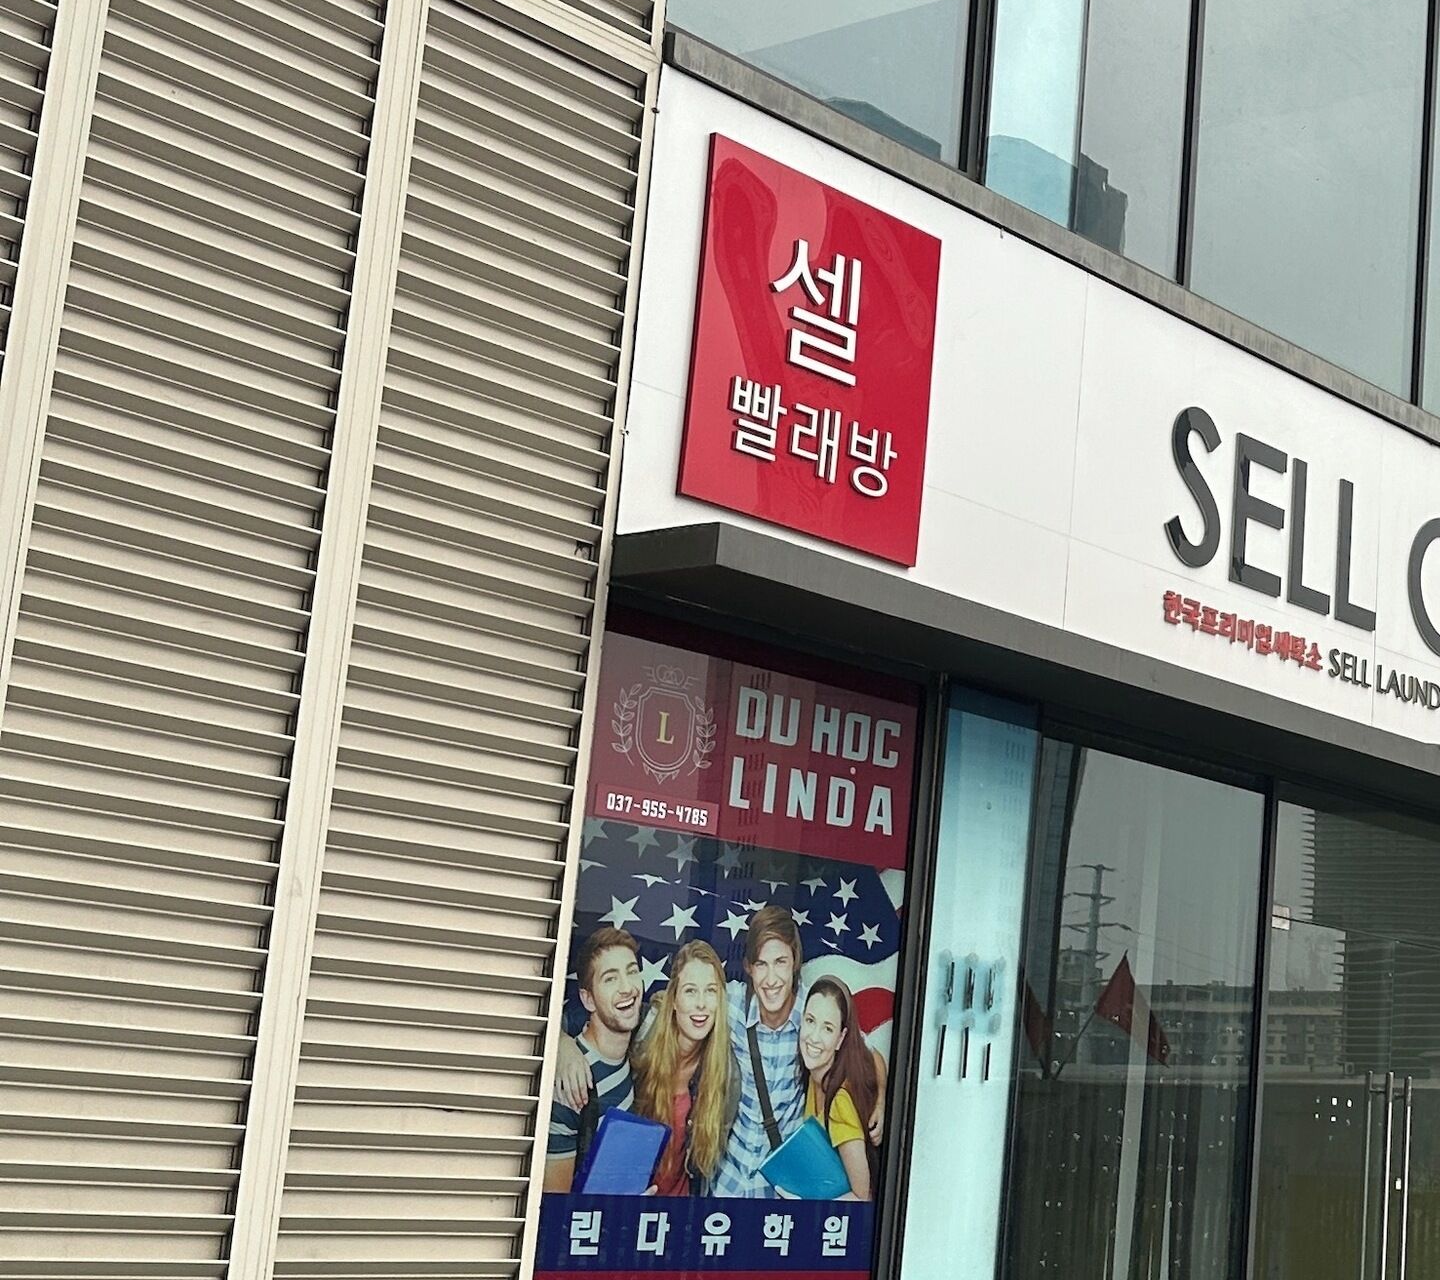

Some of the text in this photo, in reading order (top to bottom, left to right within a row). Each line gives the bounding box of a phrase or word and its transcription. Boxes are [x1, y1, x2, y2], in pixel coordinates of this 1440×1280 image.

[770, 238, 862, 386] 셀
[730, 375, 898, 498] 빨래방
[1164, 406, 1377, 631] SELL
[1328, 648, 1372, 689] SELL
[735, 685, 901, 775] DU HỌC
[606, 792, 709, 827] 037-955-4785
[729, 756, 893, 836] LINDA
